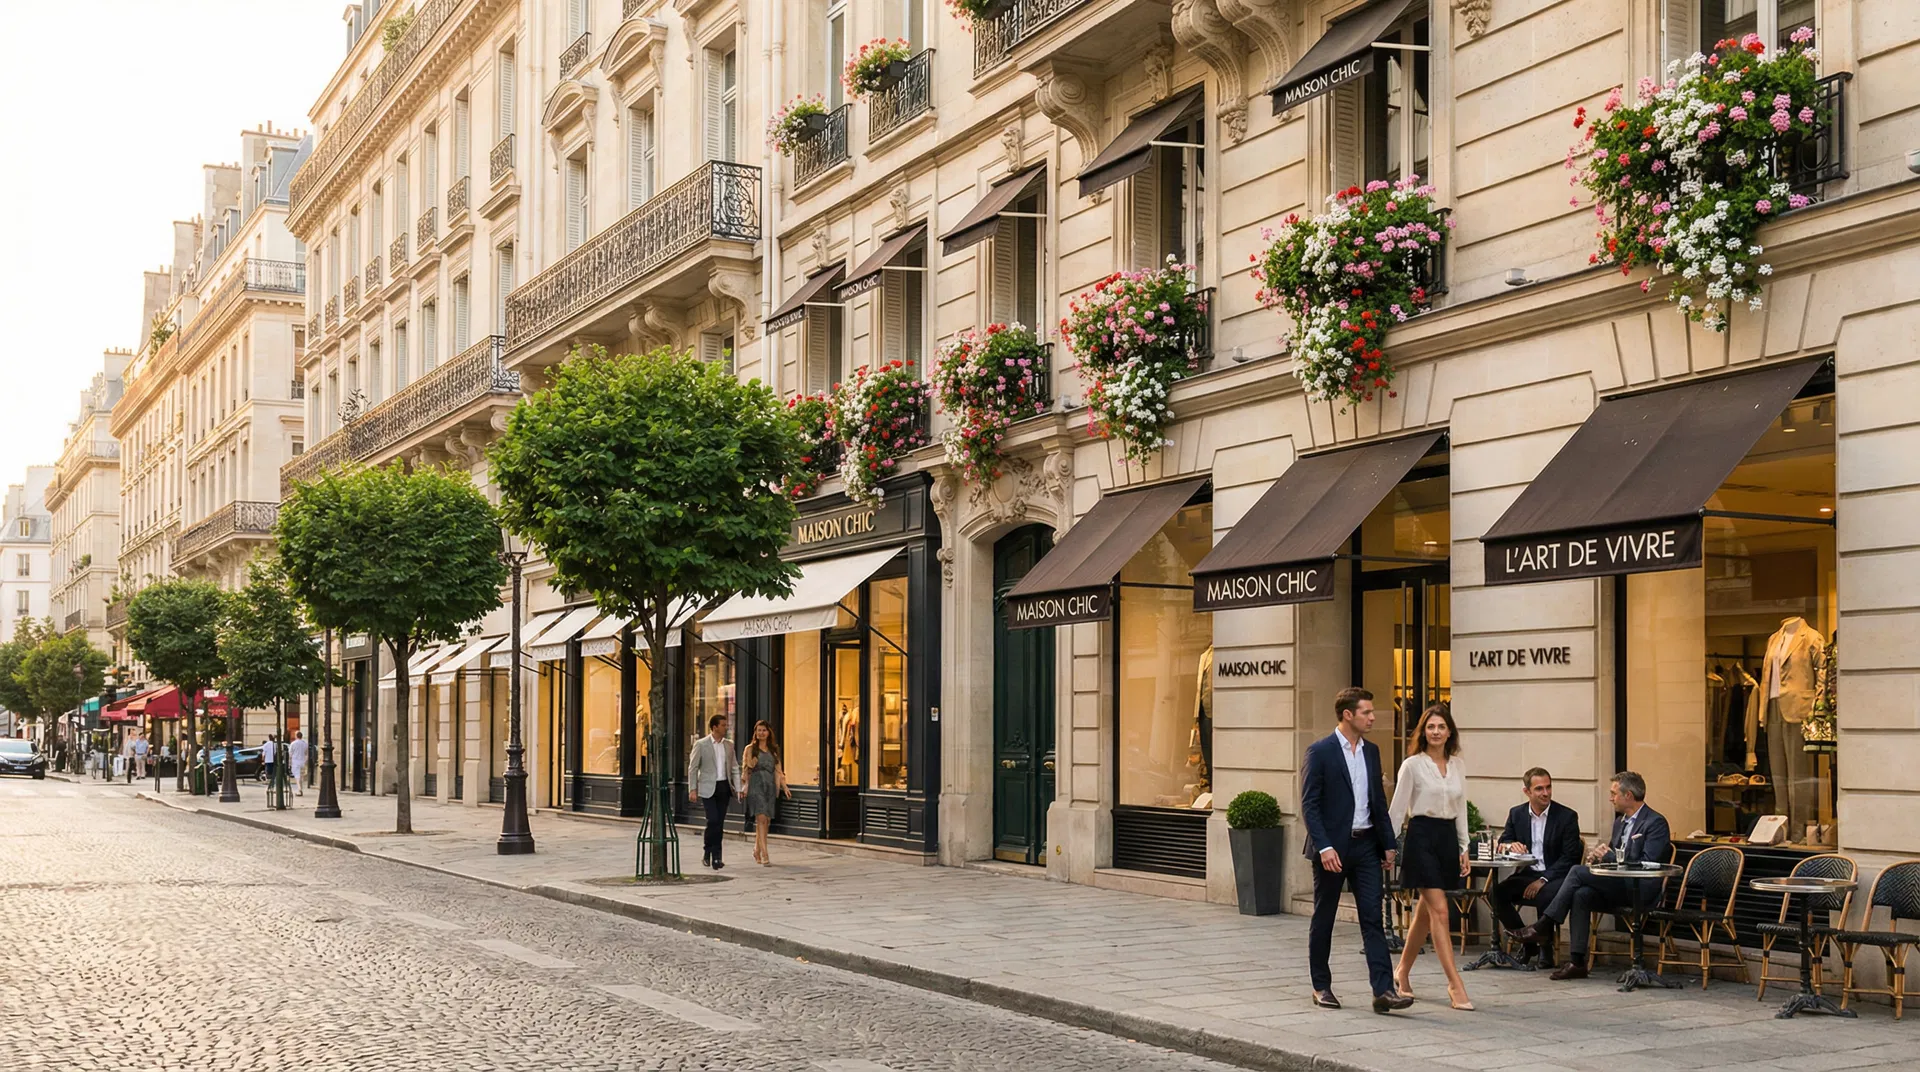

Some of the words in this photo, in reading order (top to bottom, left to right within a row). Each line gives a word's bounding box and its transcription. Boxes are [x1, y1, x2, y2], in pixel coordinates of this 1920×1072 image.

[1285, 74, 1328, 105] MAISON
[1330, 60, 1360, 83] CHIC
[797, 517, 841, 545] MAISON
[845, 510, 875, 535] CHIC
[1505, 543, 1561, 573] L'ART
[1568, 539, 1598, 567] DE
[1605, 530, 1675, 563] VIVRE
[1207, 574, 1271, 602] MAISON
[1276, 569, 1317, 595] CHIC
[1016, 598, 1065, 621] MAISON
[1068, 594, 1098, 616] CHIC
[1218, 661, 1259, 677] MAISON
[1261, 659, 1286, 675] CHIC
[1469, 650, 1504, 667] L'ART
[1507, 649, 1526, 666] DE
[1529, 646, 1571, 665] VIVRE
